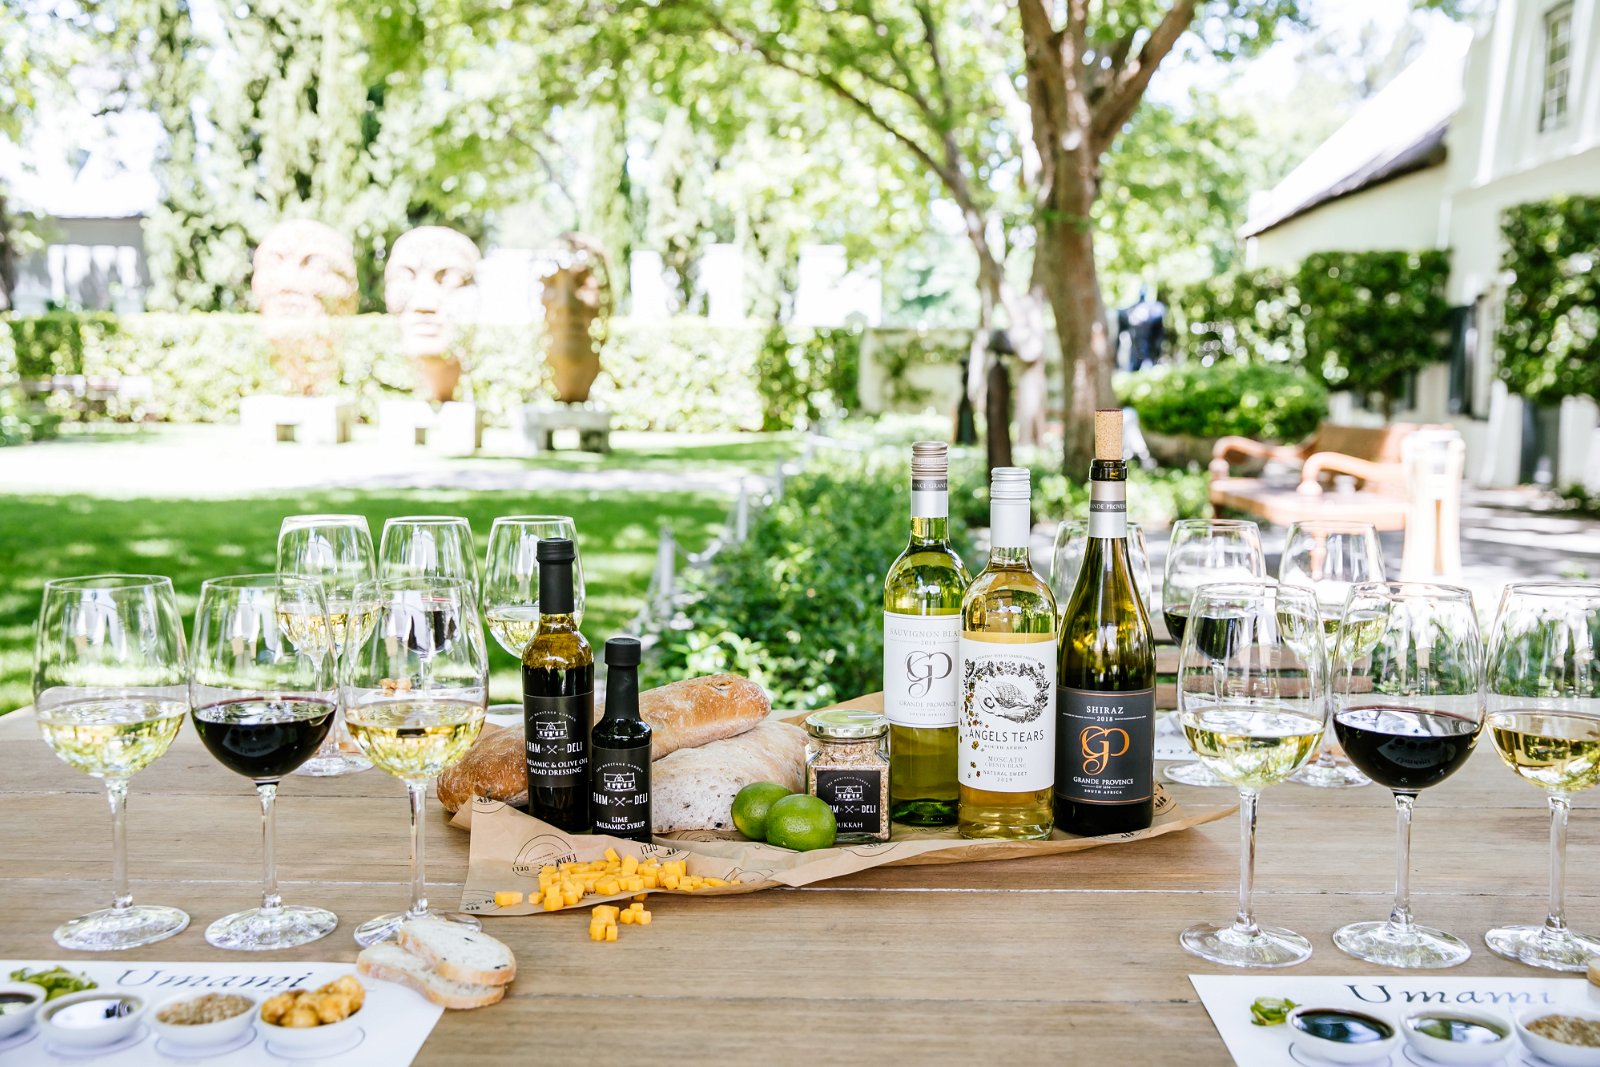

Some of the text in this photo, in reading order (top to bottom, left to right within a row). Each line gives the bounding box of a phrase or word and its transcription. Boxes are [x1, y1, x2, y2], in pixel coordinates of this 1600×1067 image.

[889, 628, 939, 638] SAUVIGNON
[899, 700, 957, 708] GRANDE PROVENCE
[1086, 705, 1124, 714] SHIRAZ
[969, 729, 1044, 742] ANGELS TEARS
[566, 741, 583, 754] DELI
[550, 761, 557, 769] &
[557, 759, 578, 768] OLIVE
[987, 755, 1023, 763] MOSCATO
[548, 766, 582, 776] DRESSING
[1073, 776, 1134, 786] GRANDE PROVENCE
[634, 792, 648, 806] DELI
[861, 804, 876, 814] DELI
[596, 820, 646, 830] BALSAMIC SYRUP
[116, 968, 314, 989] Umami
[1344, 983, 1556, 1004] Umami
